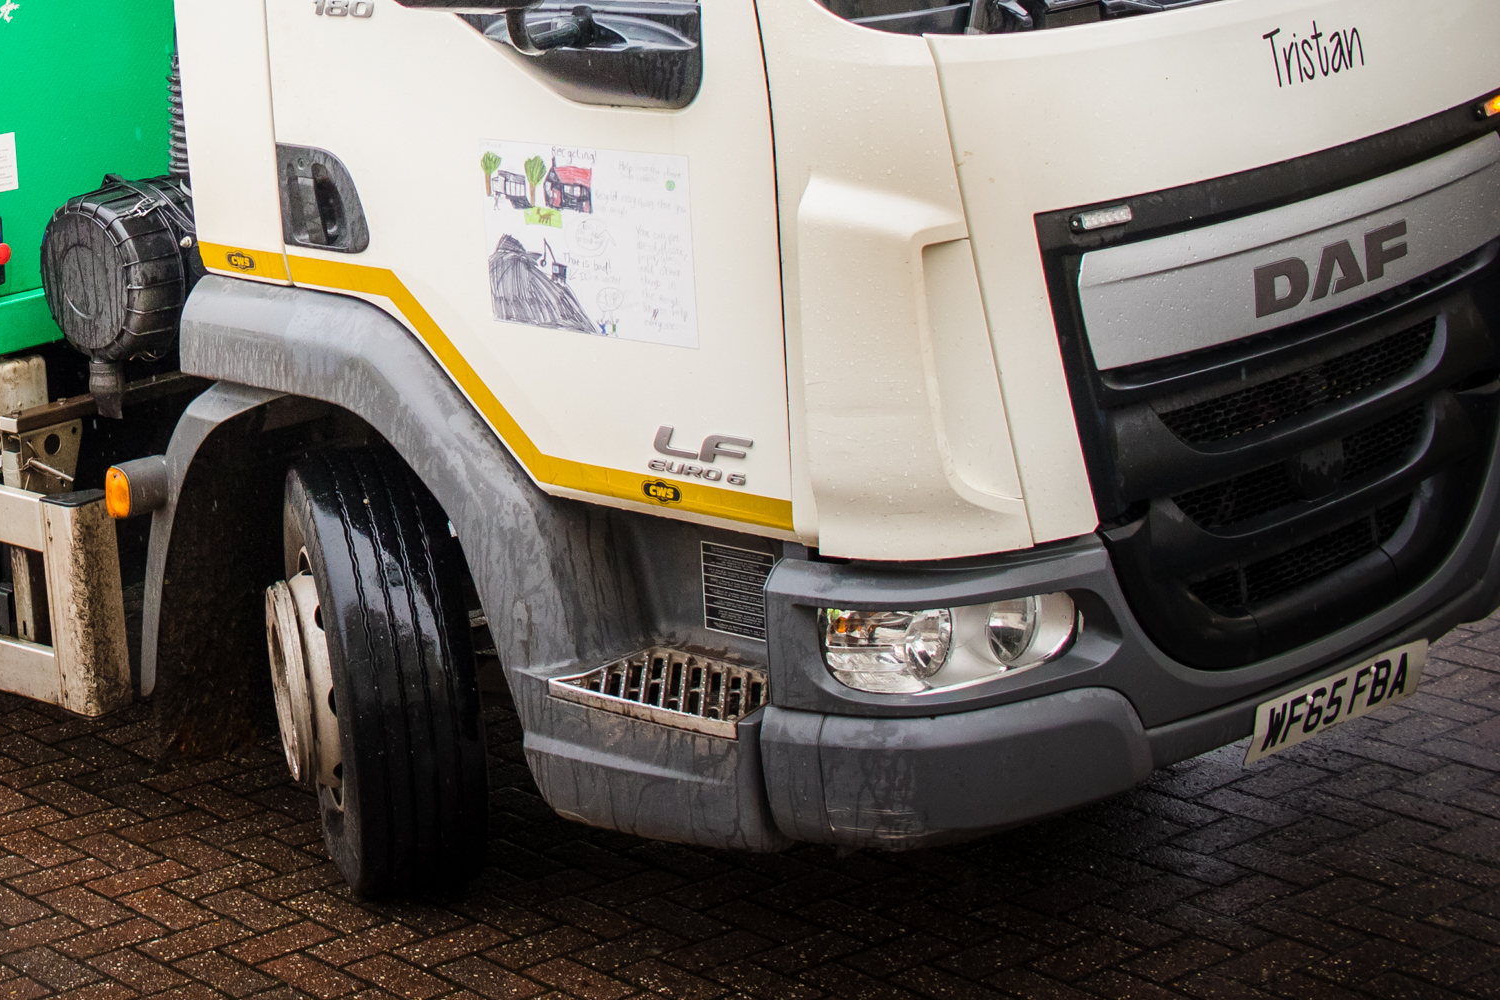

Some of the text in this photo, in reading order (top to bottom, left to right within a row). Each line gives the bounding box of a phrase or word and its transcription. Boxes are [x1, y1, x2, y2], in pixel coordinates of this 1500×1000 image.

[1262, 19, 1365, 88] Tristan
[230, 255, 251, 267] CWS
[1253, 218, 1408, 319] DAF
[653, 423, 754, 463] LF
[647, 457, 747, 486] EURO 6
[648, 484, 674, 500] CWS
[1260, 652, 1408, 752] WF65 FBA
